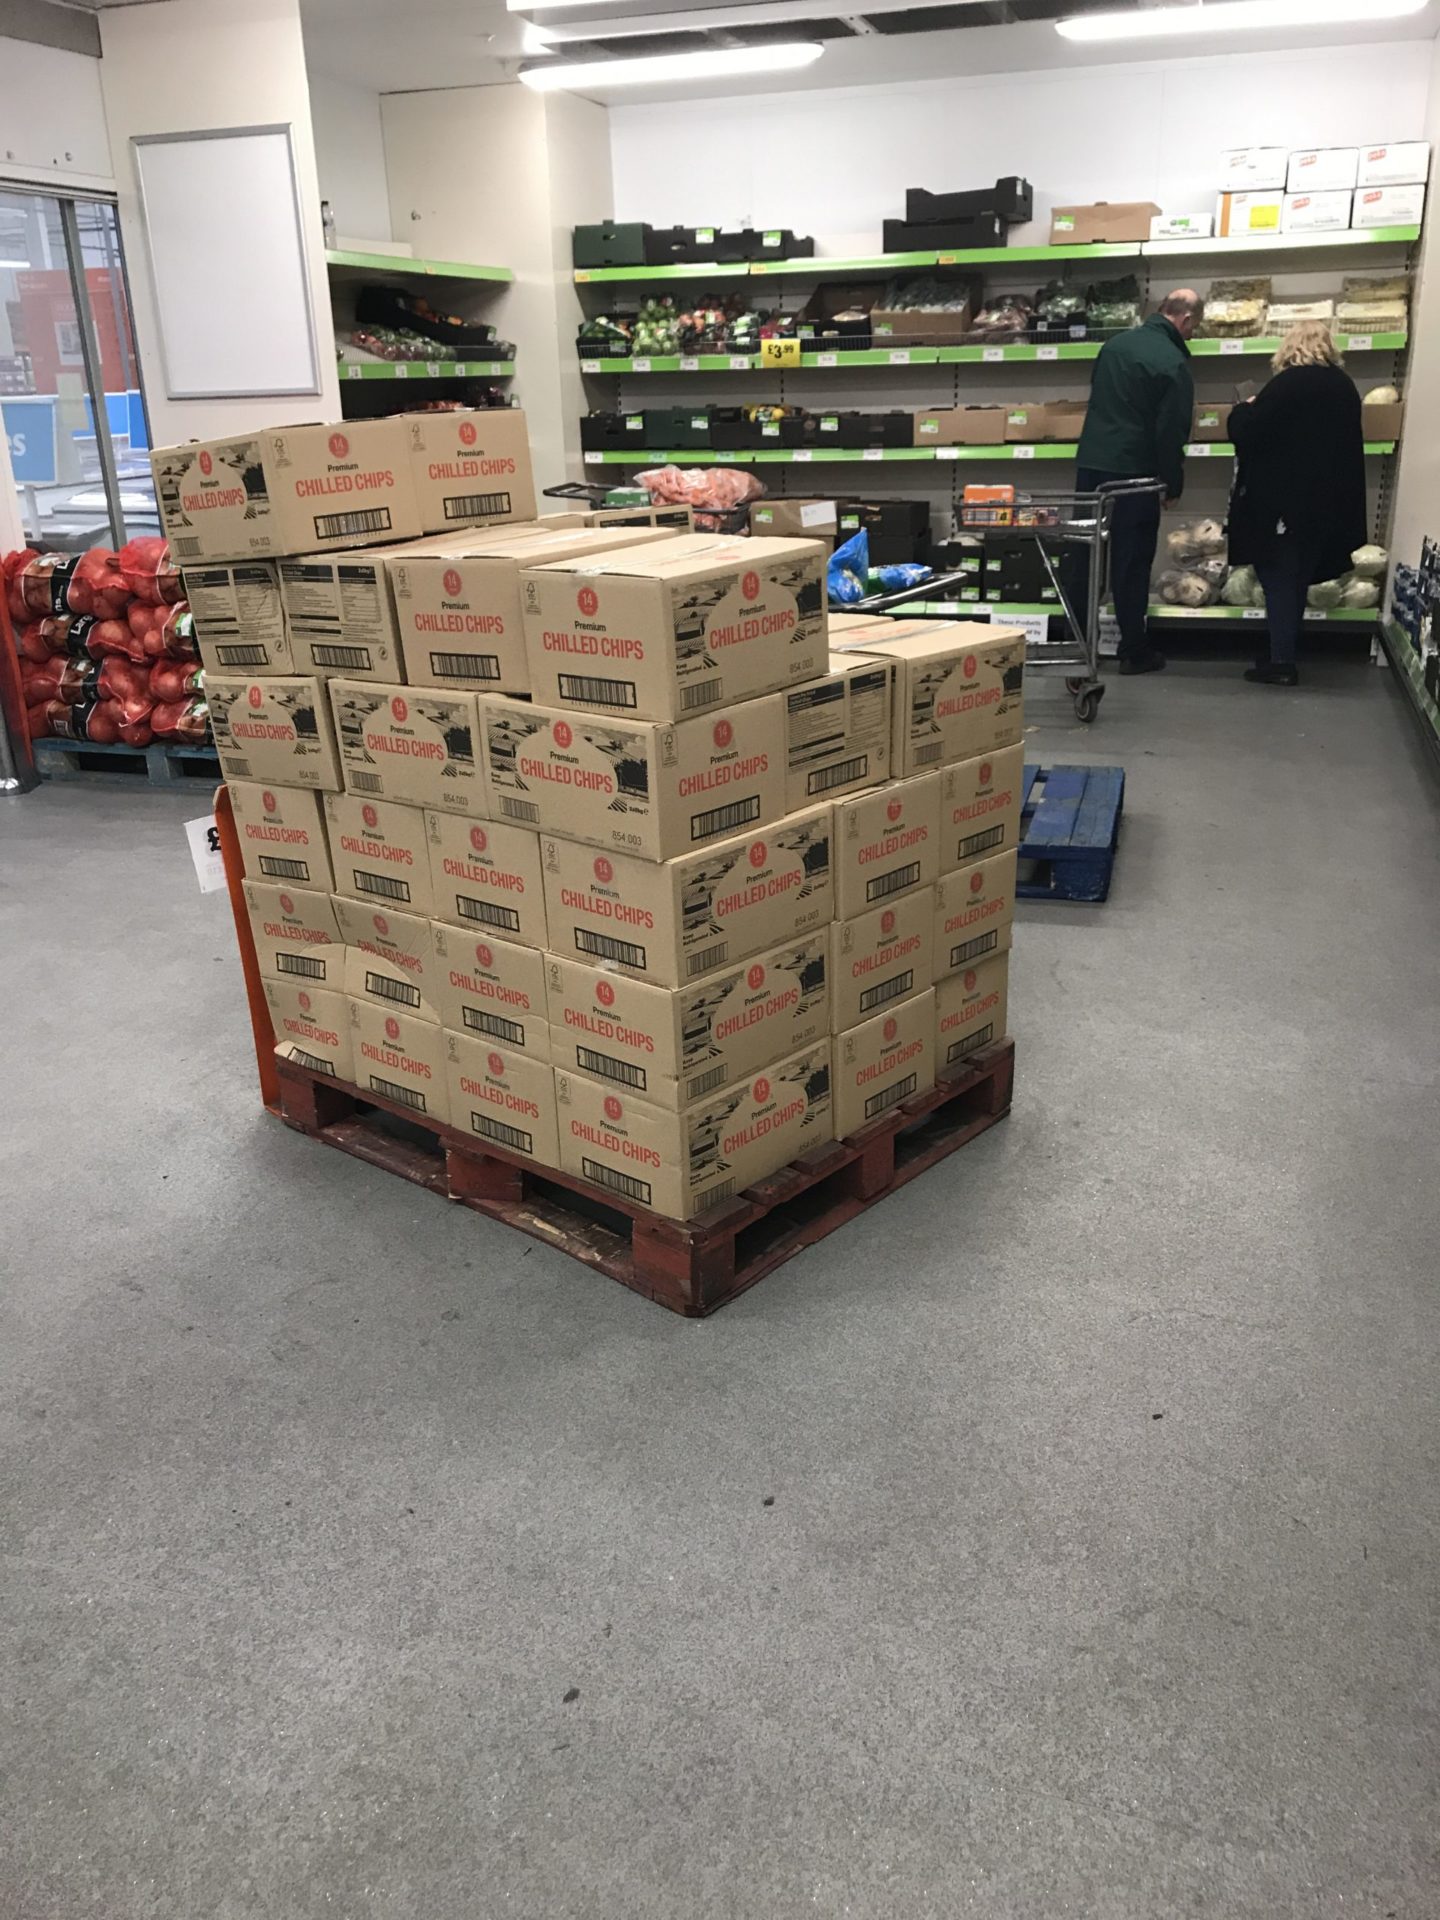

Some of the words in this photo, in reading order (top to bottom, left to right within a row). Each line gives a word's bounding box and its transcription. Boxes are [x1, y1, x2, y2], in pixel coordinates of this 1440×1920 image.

[457, 448, 485, 458] Premium
[327, 462, 358, 473] Premium
[428, 461, 479, 480] CHILLED
[480, 458, 515, 476] CHIPS
[296, 473, 353, 498] CHILLED
[355, 471, 394, 489] CHIPS
[183, 491, 217, 513] CHILLED
[217, 488, 244, 507] CHIPS
[441, 601, 470, 611] Premium
[739, 604, 766, 617] Premium
[414, 613, 464, 633] CHILLED
[465, 615, 504, 635] CHIPS
[574, 620, 606, 632] Premium
[710, 620, 759, 650] CHILLED
[762, 610, 795, 635] CHIPS
[543, 632, 598, 655] CHILLED
[601, 636, 644, 660] CHIPS
[937, 694, 974, 718] CHILLED
[975, 688, 1000, 707] CHIPS
[232, 723, 266, 738] CHILLED
[268, 724, 294, 741] CHIPS
[390, 725, 414, 736] Premium
[367, 734, 409, 756] CHILLED
[412, 741, 444, 760] CHIPS
[550, 751, 579, 764] Premium
[710, 750, 738, 764] Premium
[520, 758, 571, 784] CHILLED
[574, 769, 613, 794] CHIPS
[679, 764, 730, 797] CHILLED
[732, 754, 768, 779] CHIPS
[952, 800, 988, 824] CHILLED
[989, 791, 1012, 811] CHIPS
[246, 824, 280, 842] CHILLED
[282, 828, 309, 845] CHIPS
[362, 830, 384, 840] Premium
[612, 830, 626, 842] 854
[628, 834, 642, 846] 003
[883, 824, 905, 836] Premium
[341, 836, 381, 858] CHILLED
[382, 846, 412, 865] CHIPS
[858, 838, 898, 865] CHILLED
[900, 826, 928, 848] CHIPS
[468, 853, 494, 866] Premium
[444, 858, 488, 882] CHILLED
[490, 865, 524, 893] CHIPS
[746, 868, 772, 884] Premium
[590, 884, 620, 899] Premium
[717, 884, 766, 917] CHILLED
[768, 870, 800, 896] CHIPS
[561, 888, 611, 917] CHILLED
[615, 904, 654, 929] CHIPS
[944, 908, 980, 934] CHILLED
[982, 897, 1004, 918] CHIPS
[264, 922, 300, 941] CHILLED
[302, 927, 332, 944] CHIPS
[358, 940, 396, 962] CHILLED
[396, 951, 424, 974] CHIPS
[852, 948, 892, 978] CHILLED
[894, 935, 920, 958] CHIPS
[474, 968, 500, 982] Premium
[450, 971, 494, 998] CHILLED
[496, 986, 530, 1010] CHIPS
[745, 990, 770, 1006] Premium
[592, 1006, 622, 1022] Premium
[716, 1006, 764, 1040] CHILLED
[766, 988, 798, 1016] CHIPS
[940, 1006, 976, 1033] CHILLED
[977, 991, 999, 1014] CHIPS
[283, 1018, 313, 1038] CHILLED
[313, 1026, 339, 1046] CHIPS
[564, 1008, 614, 1039] CHILLED
[616, 1024, 654, 1052] CHIPS
[382, 1040, 404, 1052] Premium
[361, 1042, 398, 1069] CHILLED
[400, 1057, 432, 1080] CHIPS
[856, 1055, 896, 1086] CHILLED
[897, 1039, 924, 1064] CHIPS
[485, 1075, 510, 1090] Premium
[460, 1076, 504, 1106] CHILLED
[506, 1093, 539, 1119] CHIPS
[751, 1102, 777, 1120] Premium
[600, 1120, 628, 1137] Premium
[724, 1120, 771, 1154] CHILLED
[773, 1099, 804, 1129] CHIPS
[571, 1120, 620, 1152] CHILLED
[622, 1140, 660, 1168] CHIPS
